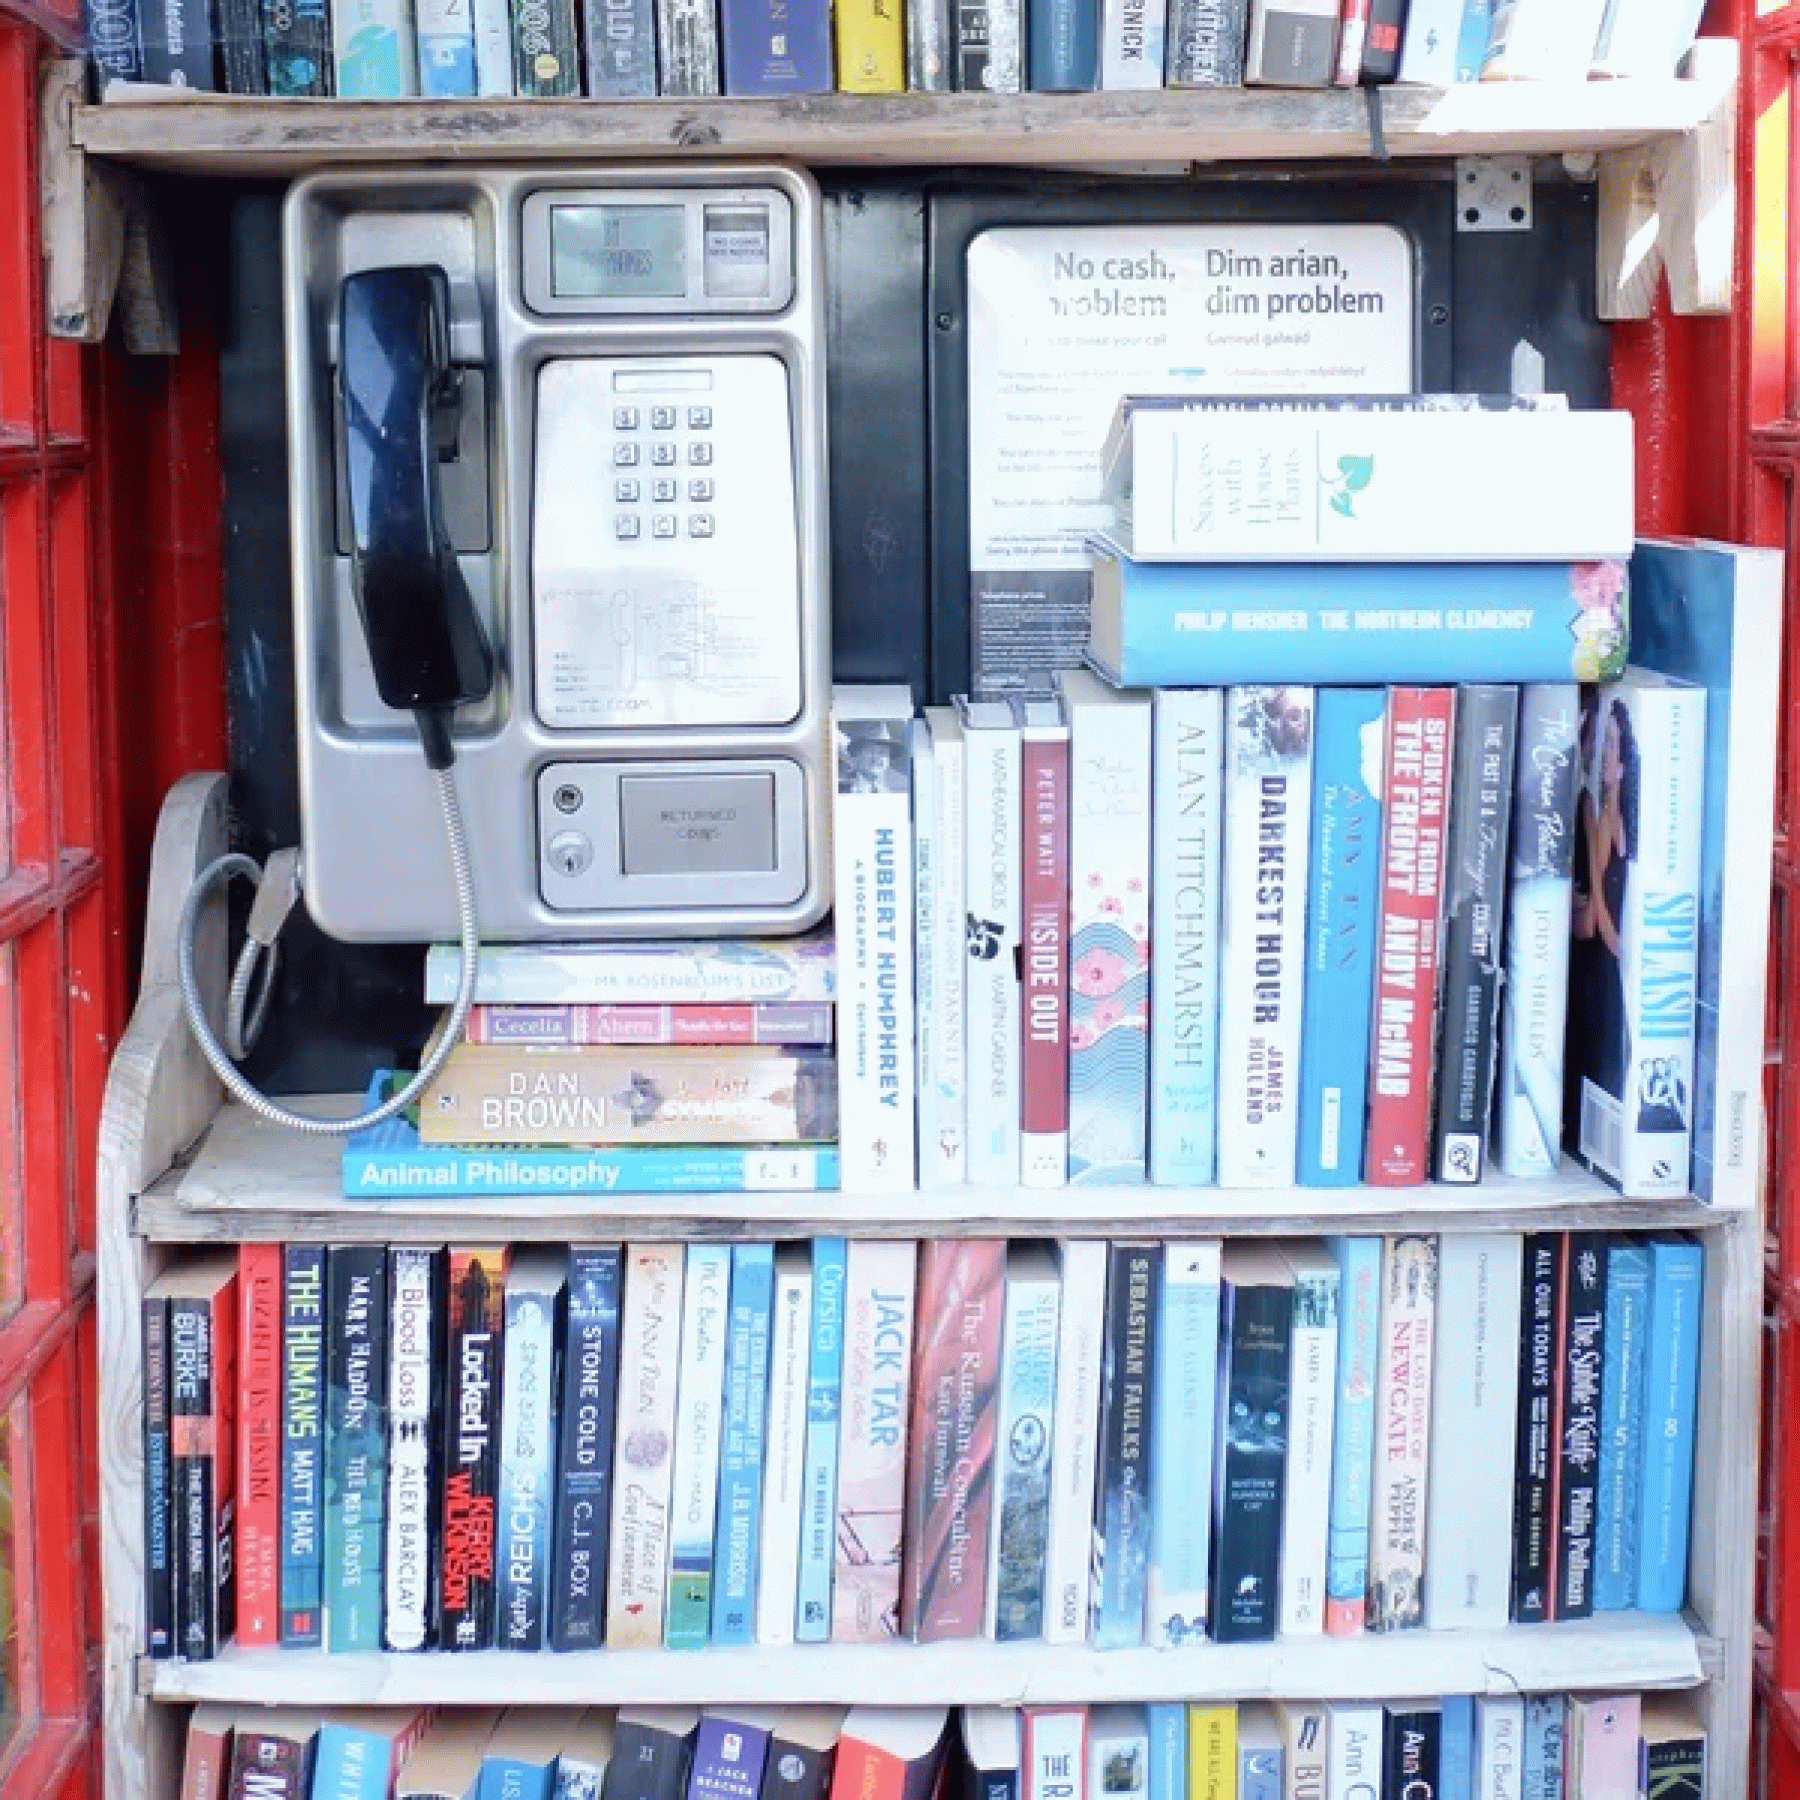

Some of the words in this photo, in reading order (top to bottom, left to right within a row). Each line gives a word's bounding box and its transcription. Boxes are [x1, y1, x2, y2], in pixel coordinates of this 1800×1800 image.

[1054, 252, 1094, 280] No
[1102, 250, 1176, 281] cash,
[1205, 249, 1260, 277] Dim
[1269, 248, 1349, 280] arian,
[1205, 285, 1259, 314] dim
[1268, 285, 1383, 321] problem
[1176, 721, 1206, 816] ALAN
[1393, 718, 1421, 776] THE
[1422, 717, 1446, 816] SPOKEN
[1037, 768, 1054, 825] PETER
[1256, 775, 1287, 926] DARKEST
[1387, 786, 1416, 895] FRONT
[1418, 828, 1443, 896] FROM
[874, 828, 895, 941] HUBERT
[1031, 902, 1058, 987] INSIDE
[1173, 828, 1206, 1068] TITCHMARSH
[1383, 914, 1418, 989] ANDY
[1531, 908, 1551, 962] JODY
[1639, 891, 1696, 1039] SPLASH
[1253, 934, 1282, 1025] HOUR
[495, 1017, 563, 1035] Cecelia
[877, 951, 899, 1109] HUMPHREY
[1030, 994, 1058, 1043] OUT
[1376, 997, 1414, 1097] McNAB
[1528, 973, 1547, 1059] SHIELDS
[510, 1072, 578, 1095] DAN
[1246, 1037, 1266, 1125] HOLLAND
[1265, 1045, 1283, 1113] JAMES
[482, 1097, 606, 1129] BROWN
[362, 1162, 457, 1185] Animal
[467, 1161, 620, 1189] Philosophy
[288, 1264, 320, 1316] THE
[1535, 1250, 1551, 1277] ALL
[344, 1276, 371, 1337] MARK
[401, 1288, 424, 1357] Blood
[816, 1263, 843, 1349] Corsica
[871, 1289, 905, 1371] JACK
[961, 1298, 984, 1339] The
[1126, 1258, 1148, 1374] SEBASTIAN
[1413, 1317, 1429, 1346] THE
[1533, 1283, 1549, 1317] OUR
[1571, 1310, 1602, 1347] The
[174, 1312, 196, 1398] BURKE
[285, 1324, 321, 1437] HUMANS
[343, 1343, 370, 1428] HADDON
[399, 1361, 423, 1407] Loss
[459, 1333, 490, 1431] Locked
[581, 1325, 600, 1398] STONE
[1411, 1354, 1426, 1390] LAST
[1531, 1323, 1549, 1386] TODAYS
[1568, 1351, 1600, 1404] Subtle
[870, 1381, 901, 1446] TAR
[936, 1375, 954, 1415] Kate
[955, 1351, 981, 1451] Russian
[1121, 1382, 1143, 1459] FAULKS
[1387, 1321, 1411, 1463] NEWGATE
[459, 1436, 489, 1463] In
[576, 1405, 598, 1465] COLD
[933, 1420, 952, 1498] Furnivall
[1561, 1406, 1597, 1473] Knife
[290, 1450, 314, 1506] MATT
[346, 1455, 368, 1488] THE
[400, 1465, 418, 1517] ALEX
[290, 1510, 313, 1555] HAIG
[444, 1471, 471, 1610] WILKINSON
[468, 1496, 493, 1581] KERRY
[510, 1475, 536, 1585] REICHS
[948, 1458, 974, 1584] Concubine
[1386, 1482, 1402, 1551] PEPPER
[1400, 1474, 1417, 1554] ANDREW
[1563, 1486, 1594, 1536] Philip
[342, 1529, 364, 1588] HOUSE
[398, 1523, 418, 1613] BARCLAY
[571, 1550, 591, 1597] BOX
[1567, 1538, 1590, 1605] Pullman
[1043, 1755, 1070, 1778] THE
[1346, 1728, 1368, 1776] Ann
[1403, 1731, 1425, 1774] Ann
